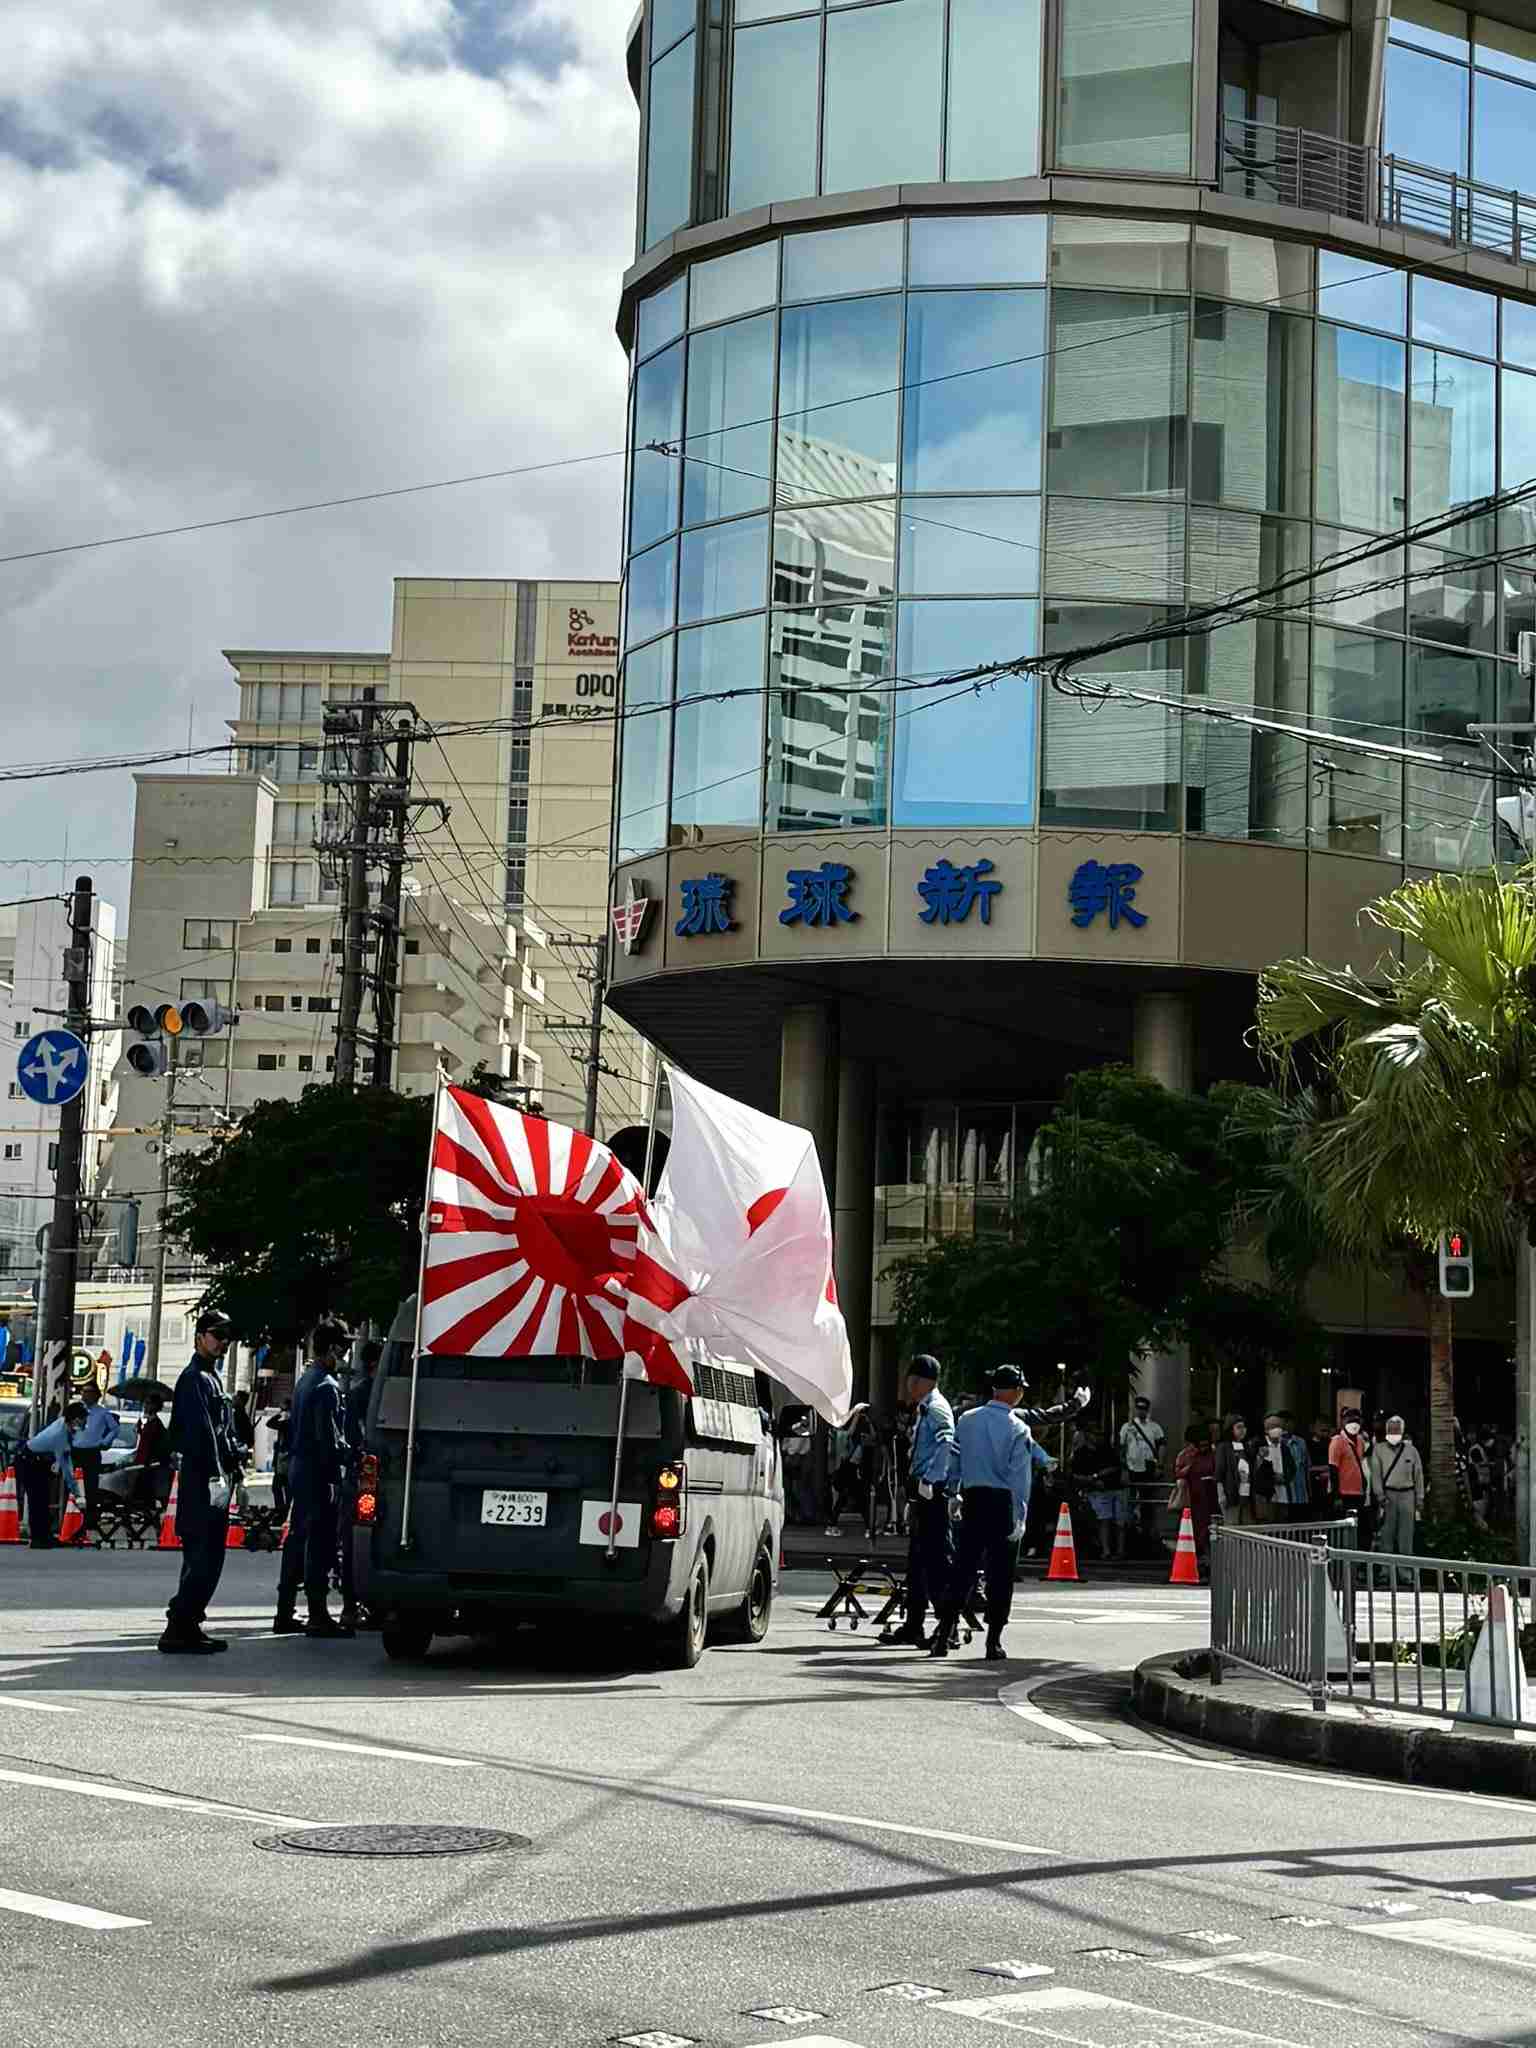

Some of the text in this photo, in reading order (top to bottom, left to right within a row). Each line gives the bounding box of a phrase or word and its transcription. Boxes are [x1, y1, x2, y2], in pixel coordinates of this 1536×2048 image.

[675, 858, 1149, 936] 琉球新報
[73, 1356, 89, 1375] P
[496, 1505, 543, 1522] 22-39
